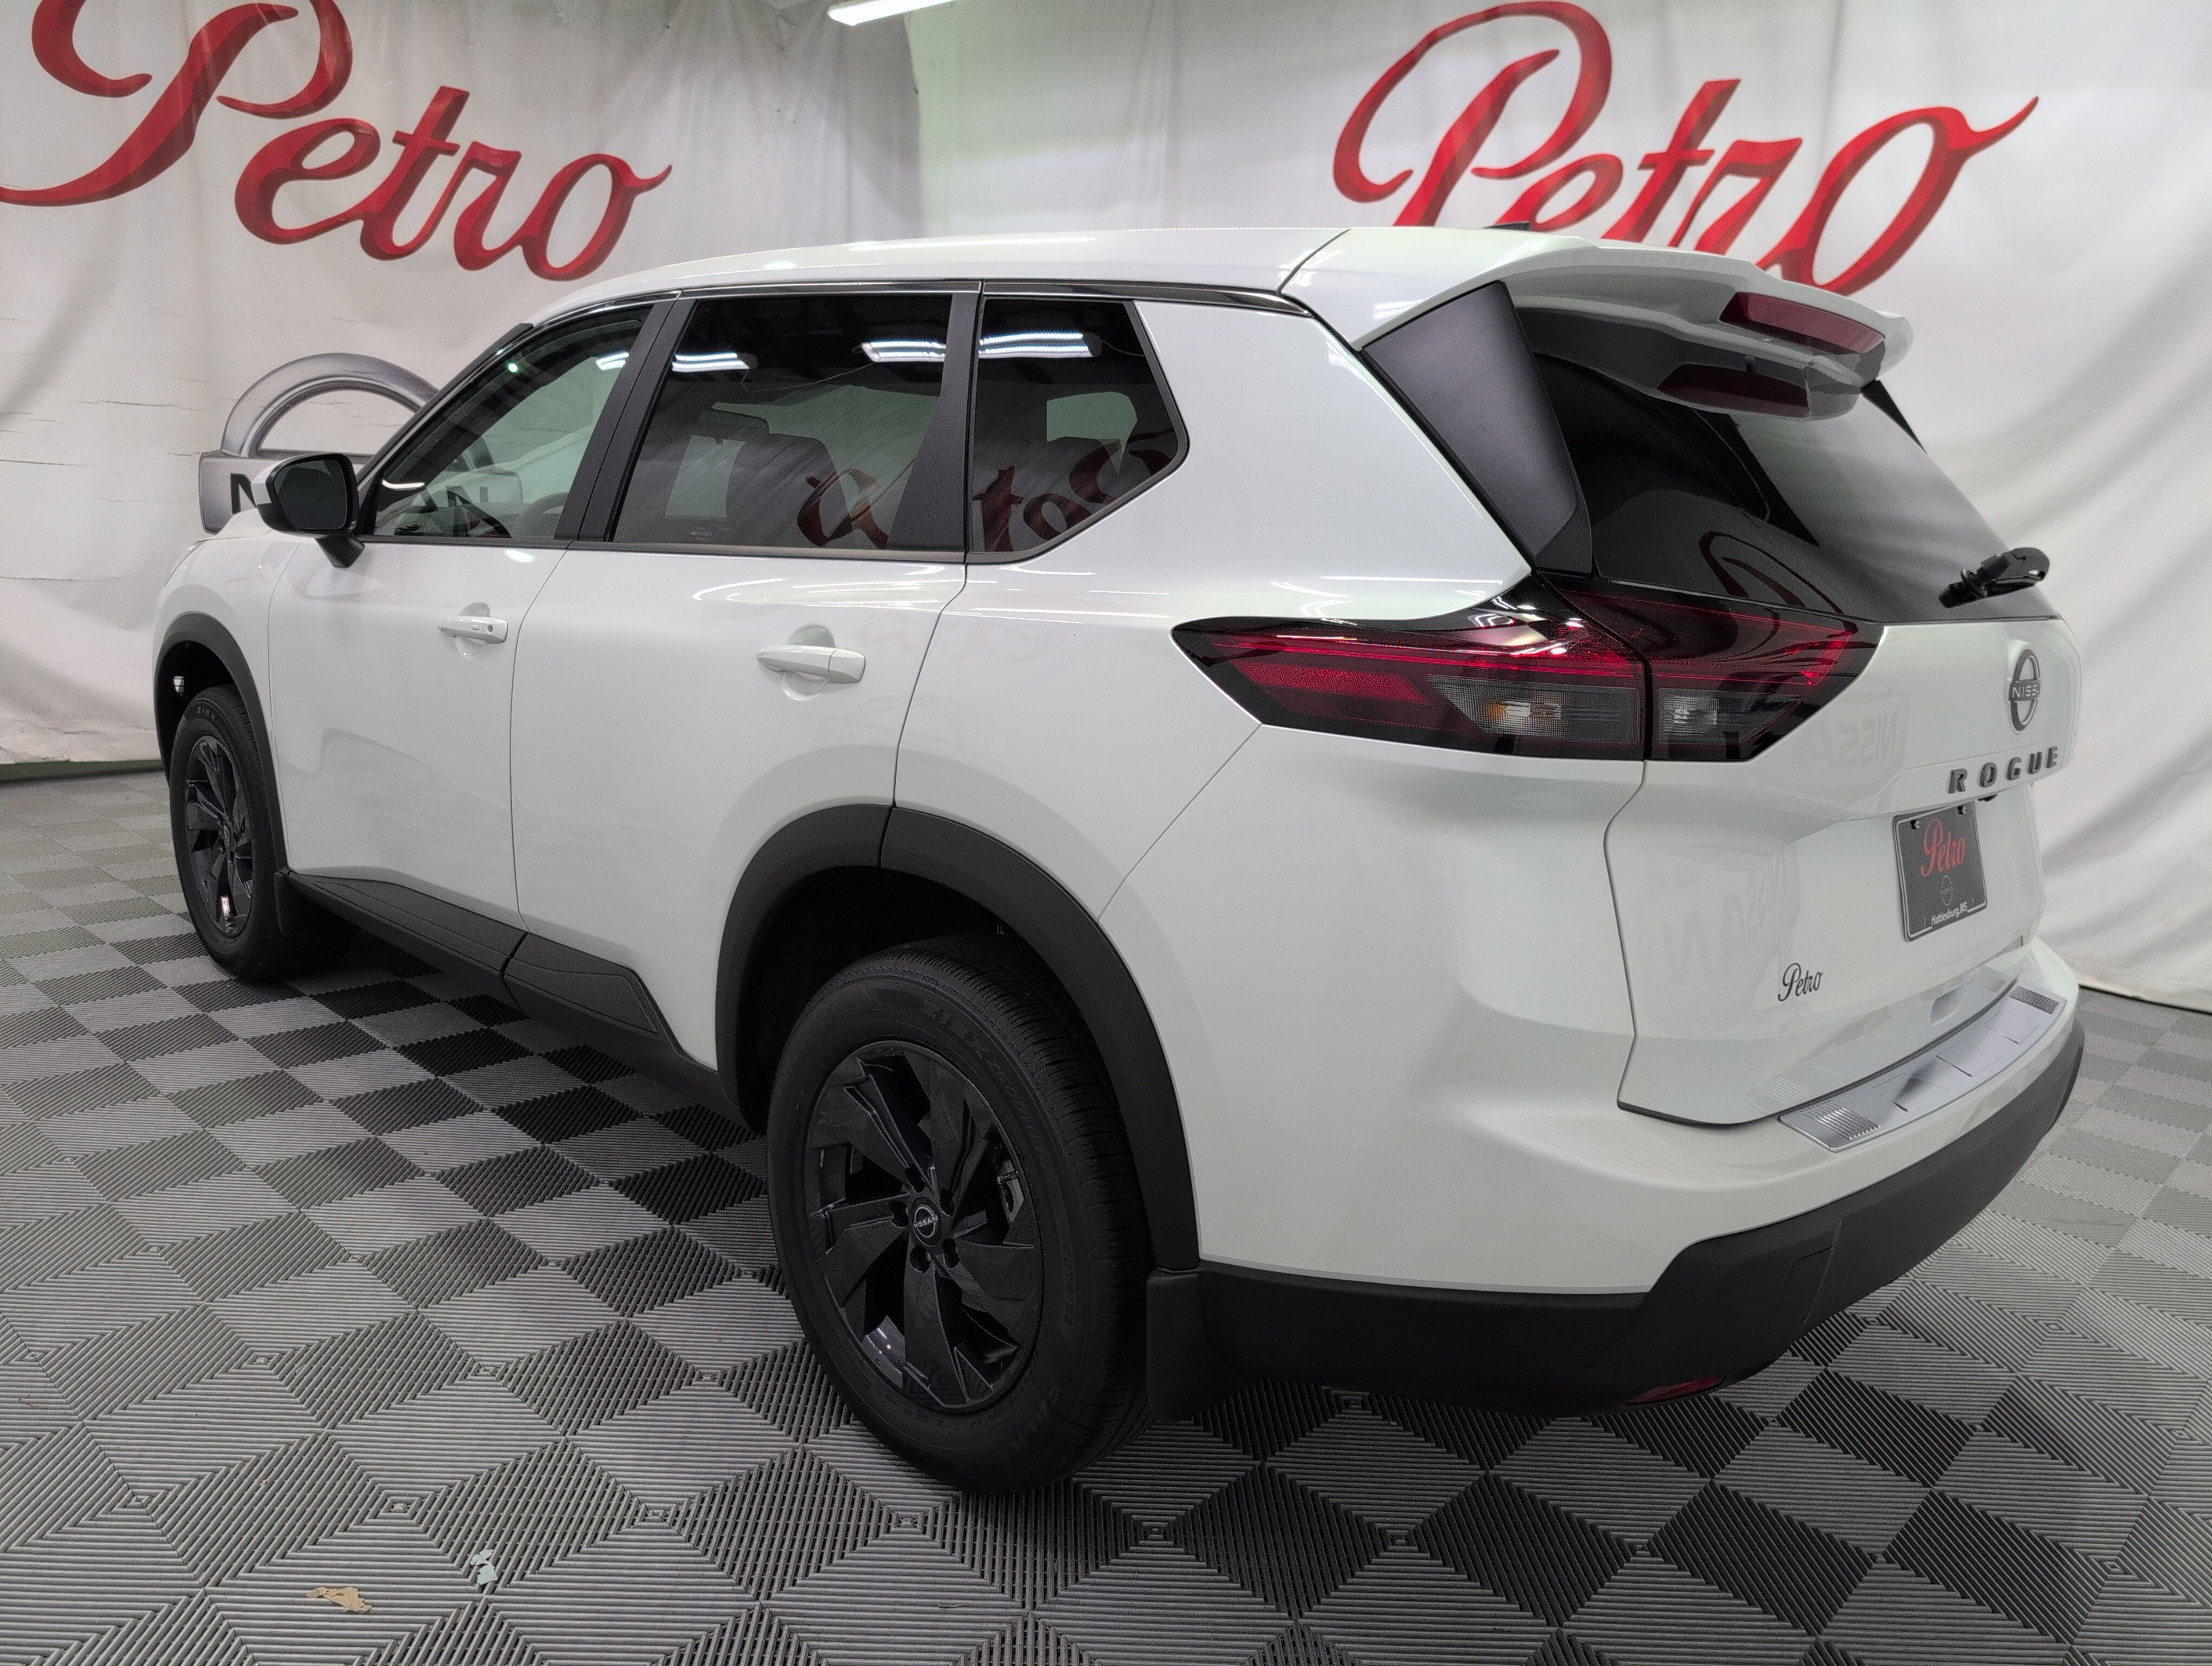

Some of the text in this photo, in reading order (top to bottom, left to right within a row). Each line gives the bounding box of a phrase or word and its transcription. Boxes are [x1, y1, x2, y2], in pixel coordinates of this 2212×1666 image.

[0, 0, 672, 281] Petro
[1333, 1, 2039, 296] Petro
[1947, 746, 2058, 794] ROGUE
[1920, 818, 1966, 877] Petro
[1778, 963, 1823, 1002] Petro
[913, 1213, 938, 1228] NISSAN
